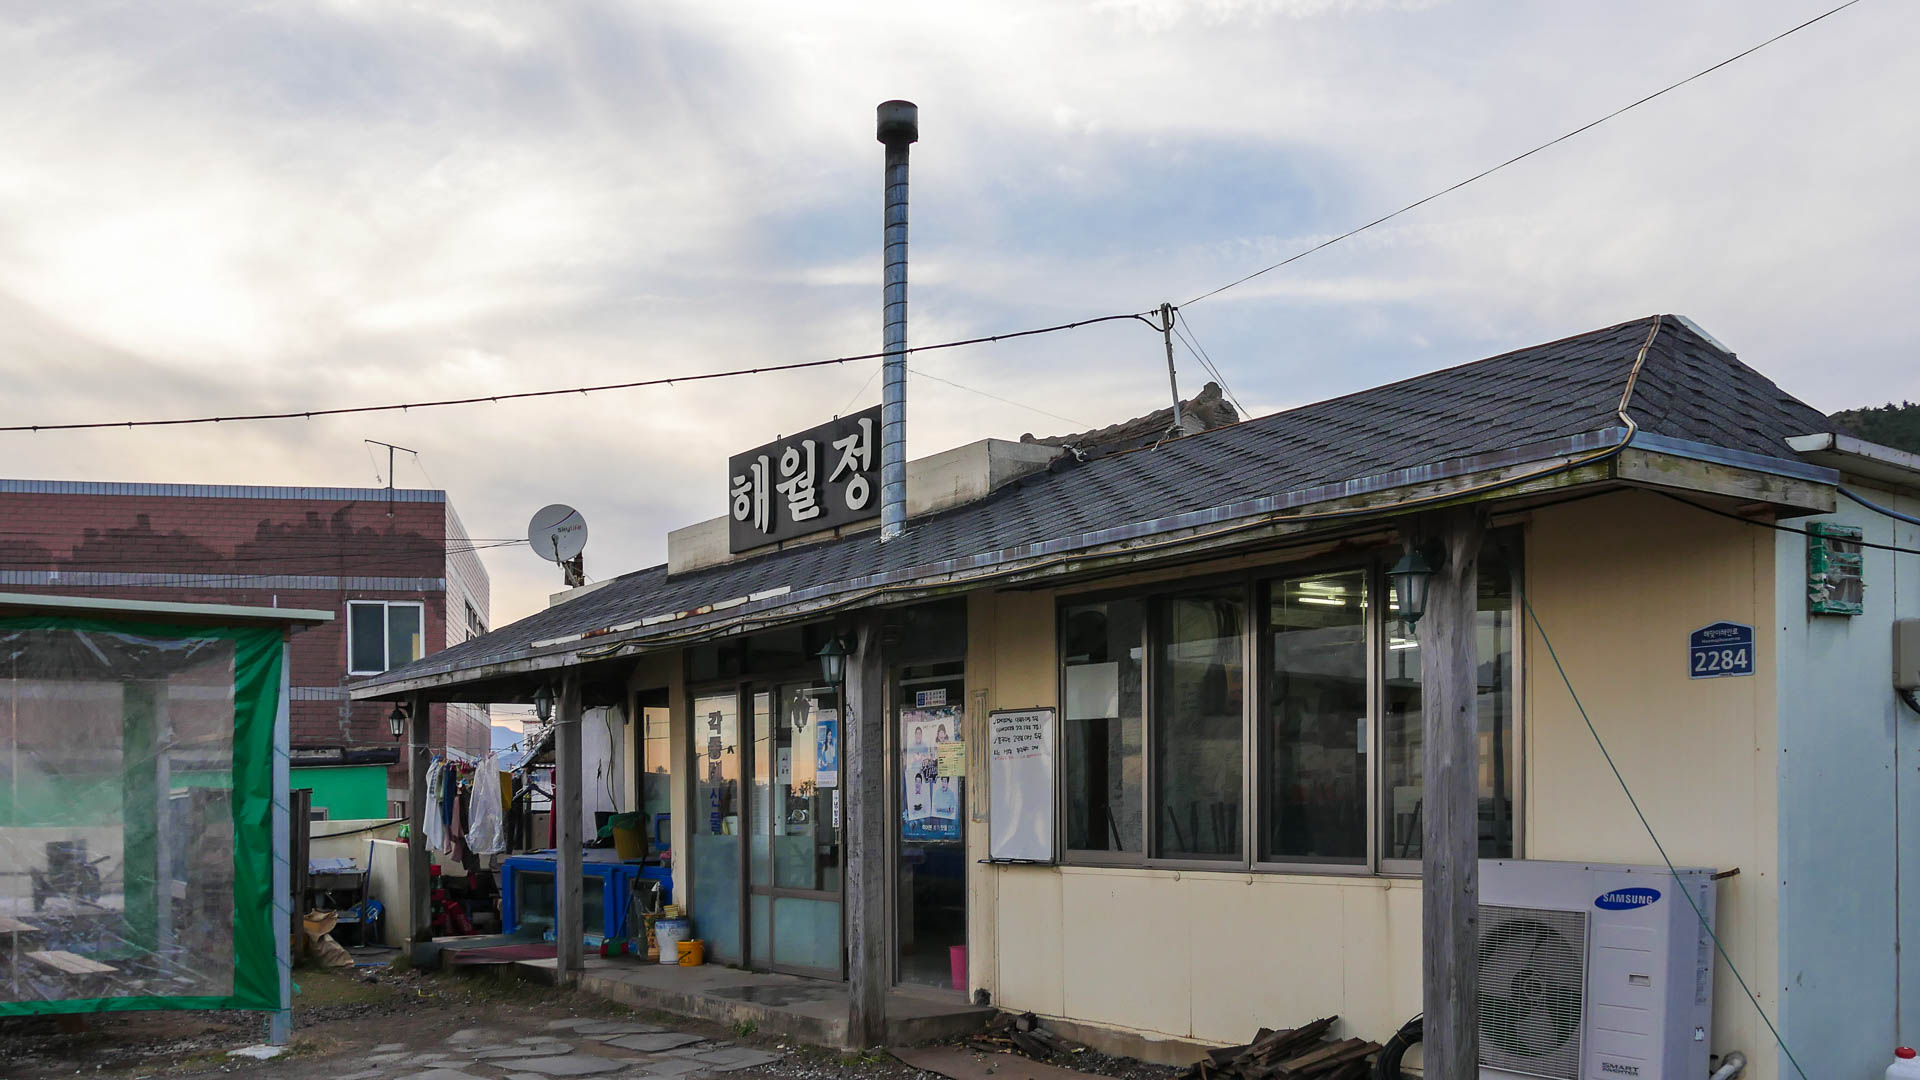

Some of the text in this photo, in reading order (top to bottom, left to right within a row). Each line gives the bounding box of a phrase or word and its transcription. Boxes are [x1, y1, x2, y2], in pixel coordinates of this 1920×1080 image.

[730, 417, 873, 534] 해월정
[1695, 648, 1748, 672] 2284
[1602, 893, 1653, 905] SAMSUNG
[1602, 1062, 1639, 1072] SMART
